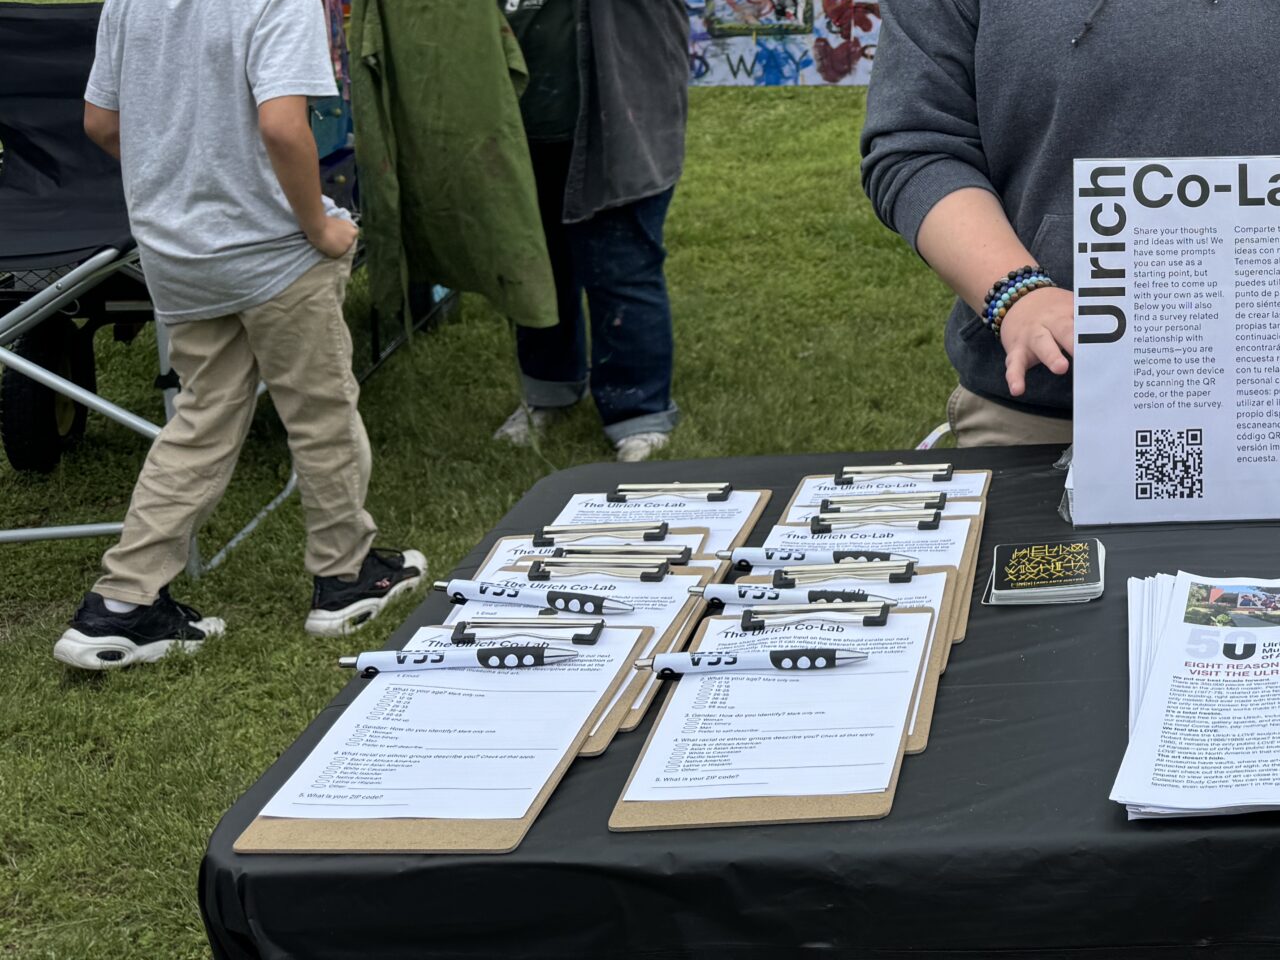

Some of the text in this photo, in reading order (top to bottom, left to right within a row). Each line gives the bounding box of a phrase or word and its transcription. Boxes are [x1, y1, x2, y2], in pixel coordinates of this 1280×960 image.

[1160, 228, 1178, 236] your
[1180, 226, 1217, 235] thoughts
[1133, 237, 1149, 245] and
[1176, 236, 1193, 244] with
[1196, 236, 1208, 244] us!
[1210, 236, 1223, 244] We
[1078, 166, 1127, 344] Ulrich
[1181, 247, 1215, 257] prompts
[1134, 269, 1165, 279] starting
[1168, 269, 1192, 279] point,
[1134, 280, 1149, 288] feel
[1152, 280, 1168, 288] free
[1207, 281, 1217, 289] up
[1134, 291, 1151, 299] with
[1153, 292, 1172, 300] your
[1161, 303, 1176, 311] you
[1178, 301, 1192, 309] will
[1194, 301, 1212, 309] also
[1160, 314, 1187, 322] survey
[1144, 325, 1163, 333] your
[1165, 323, 1201, 333] personal
[1134, 333, 1203, 344] relationship with
[1202, 355, 1215, 363] the
[1134, 367, 1154, 377] iPad,
[1196, 366, 1224, 374] device
[1134, 377, 1215, 388] by scanning the QR
[1133, 389, 1157, 399] code,
[1170, 389, 1184, 397] the
[1186, 390, 1211, 398] paper
[1167, 400, 1175, 408] of
[1178, 400, 1191, 408] the
[850, 532, 894, 540] Co-Lab
[530, 582, 567, 590] Ulrich
[570, 583, 617, 591] Co-Lab
[724, 630, 748, 639] The
[794, 622, 845, 633] Co-Lab
[427, 640, 452, 648] The
[1184, 660, 1223, 669] EIGHT
[1188, 669, 1222, 677] VISIT
